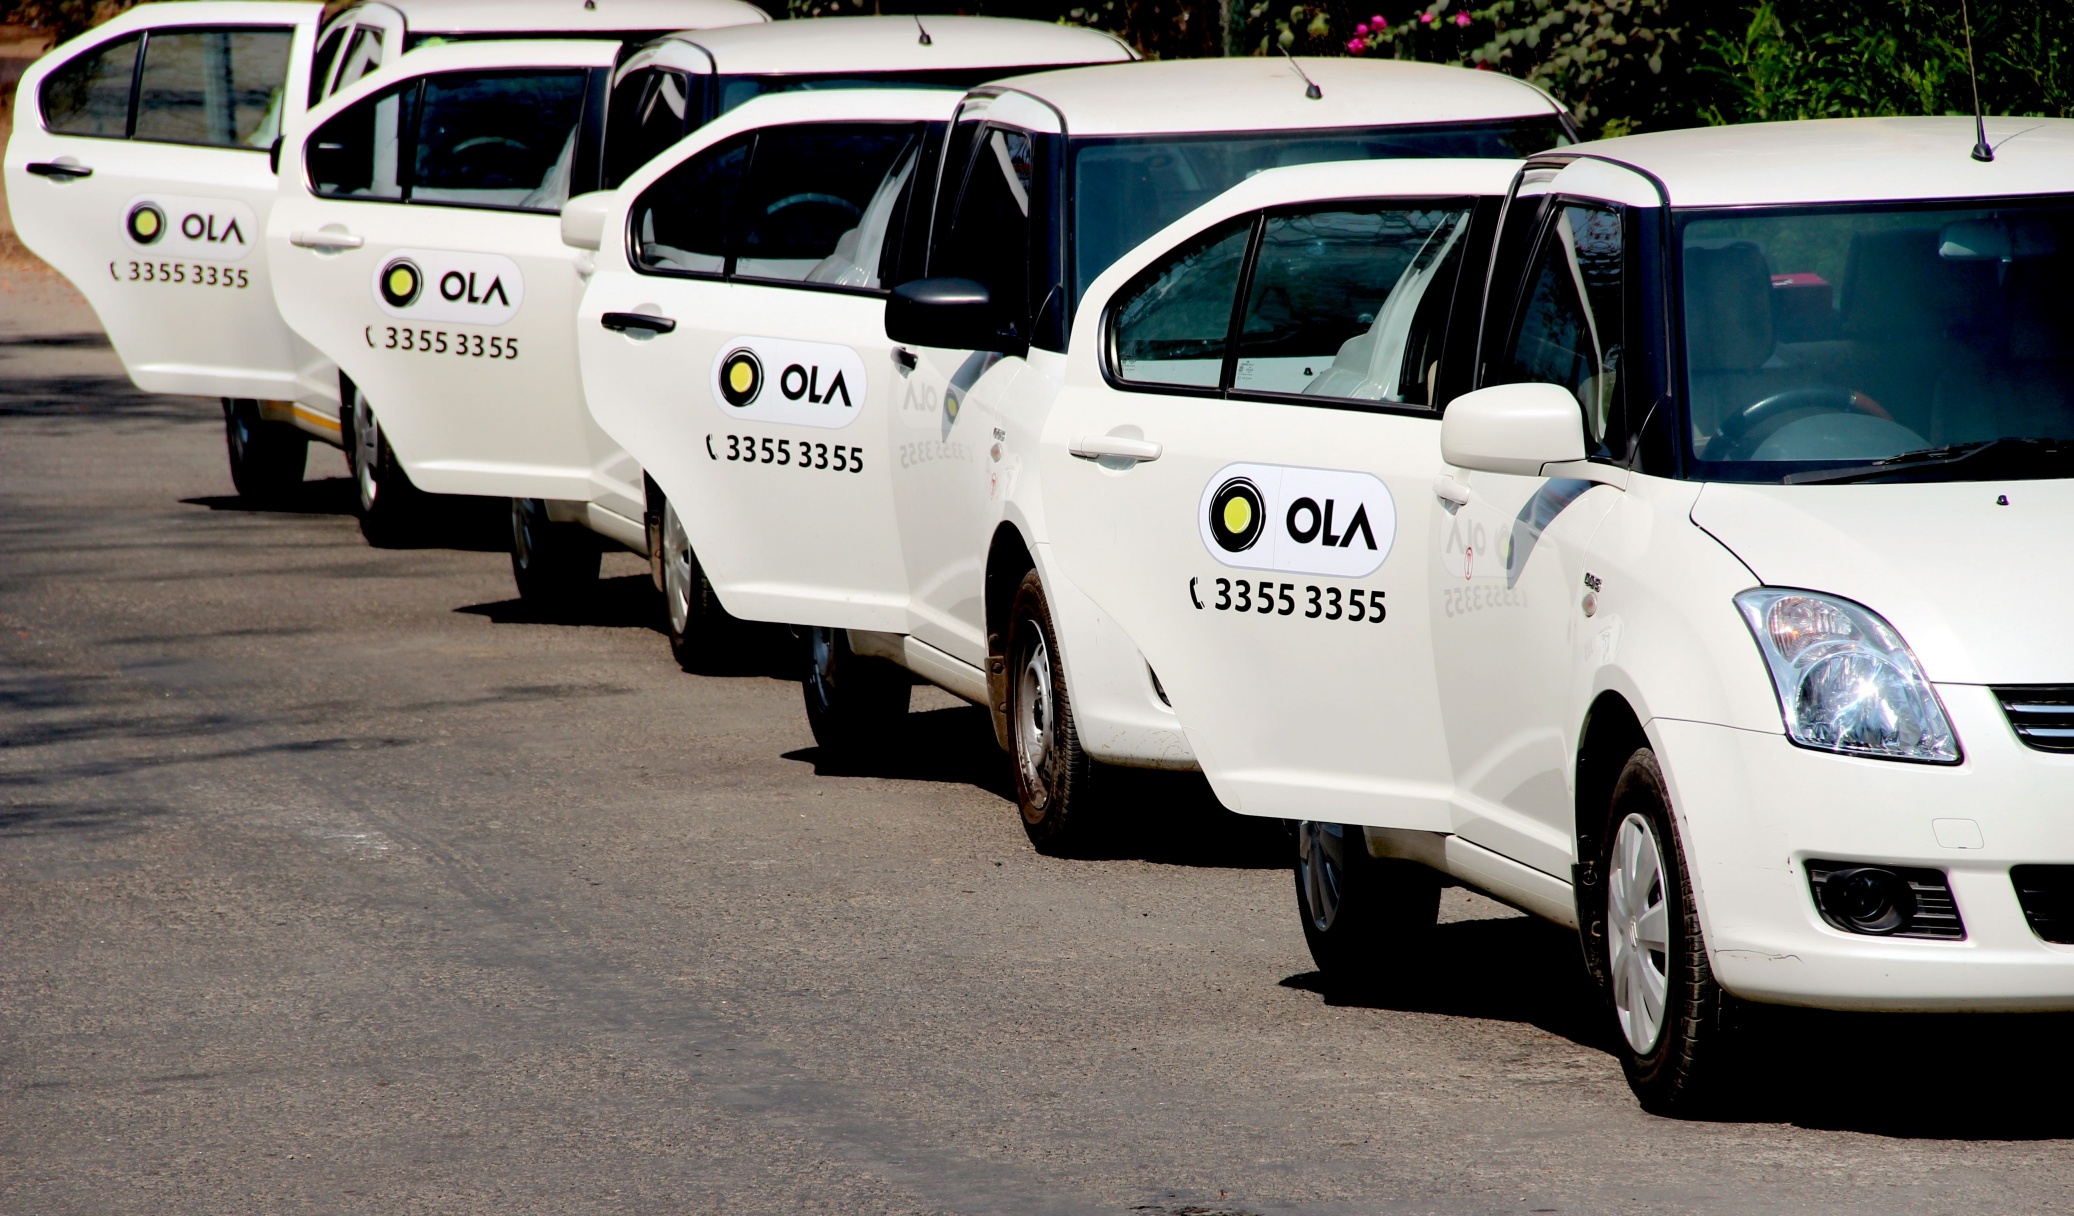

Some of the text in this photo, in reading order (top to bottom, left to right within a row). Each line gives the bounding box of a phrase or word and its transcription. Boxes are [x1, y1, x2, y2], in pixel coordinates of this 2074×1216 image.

[181, 213, 245, 245] OLA
[129, 261, 249, 289] 3355 3355
[439, 270, 510, 307] OLA
[385, 326, 519, 360] 3355 3355
[780, 363, 853, 408] OLA
[726, 434, 864, 474] 3355 3355
[1285, 496, 1378, 551] OLA
[1214, 577, 1387, 624] 3355 3355
